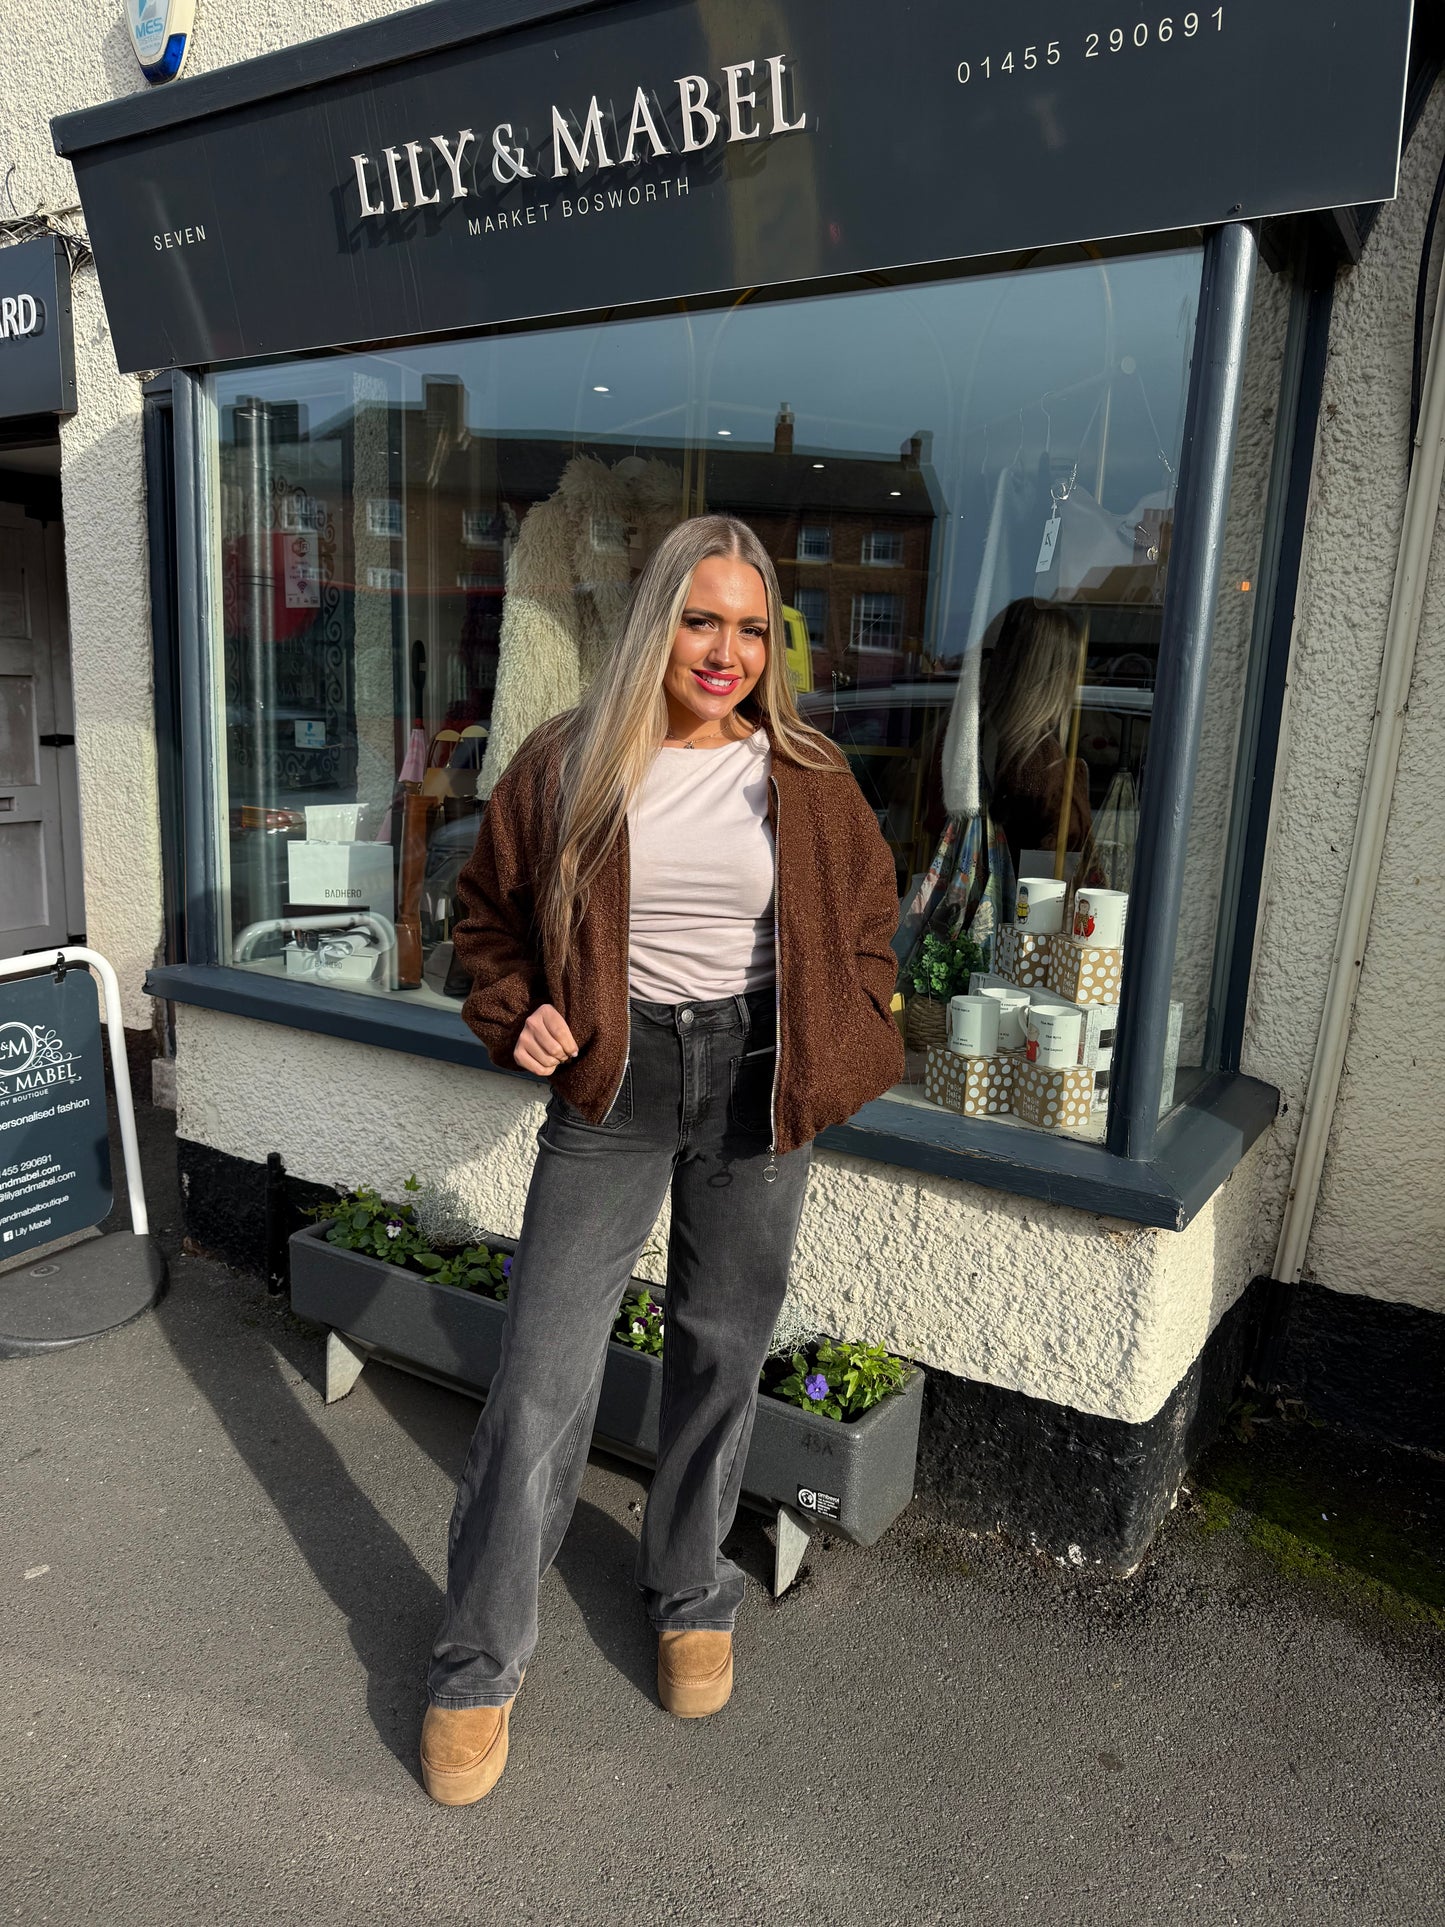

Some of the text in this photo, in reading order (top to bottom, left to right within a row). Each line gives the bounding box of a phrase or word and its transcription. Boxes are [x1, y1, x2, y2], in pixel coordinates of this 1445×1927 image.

[135, 17, 163, 39] MES
[957, 6, 1223, 84] 01455 290691
[350, 54, 807, 218] LILY & MABEL
[468, 177, 690, 236] MARKET BOSWORTH
[153, 225, 206, 251] SEVEN
[324, 888, 362, 899] BADHERO
[16, 1063, 77, 1092] MABEL
[13, 1089, 49, 1104] BOUTIQUE
[57, 1098, 90, 1114] fashion
[0, 1154, 52, 1178] 455 290691
[15, 1226, 28, 1237] Lily
[28, 1217, 52, 1232] Mabel
